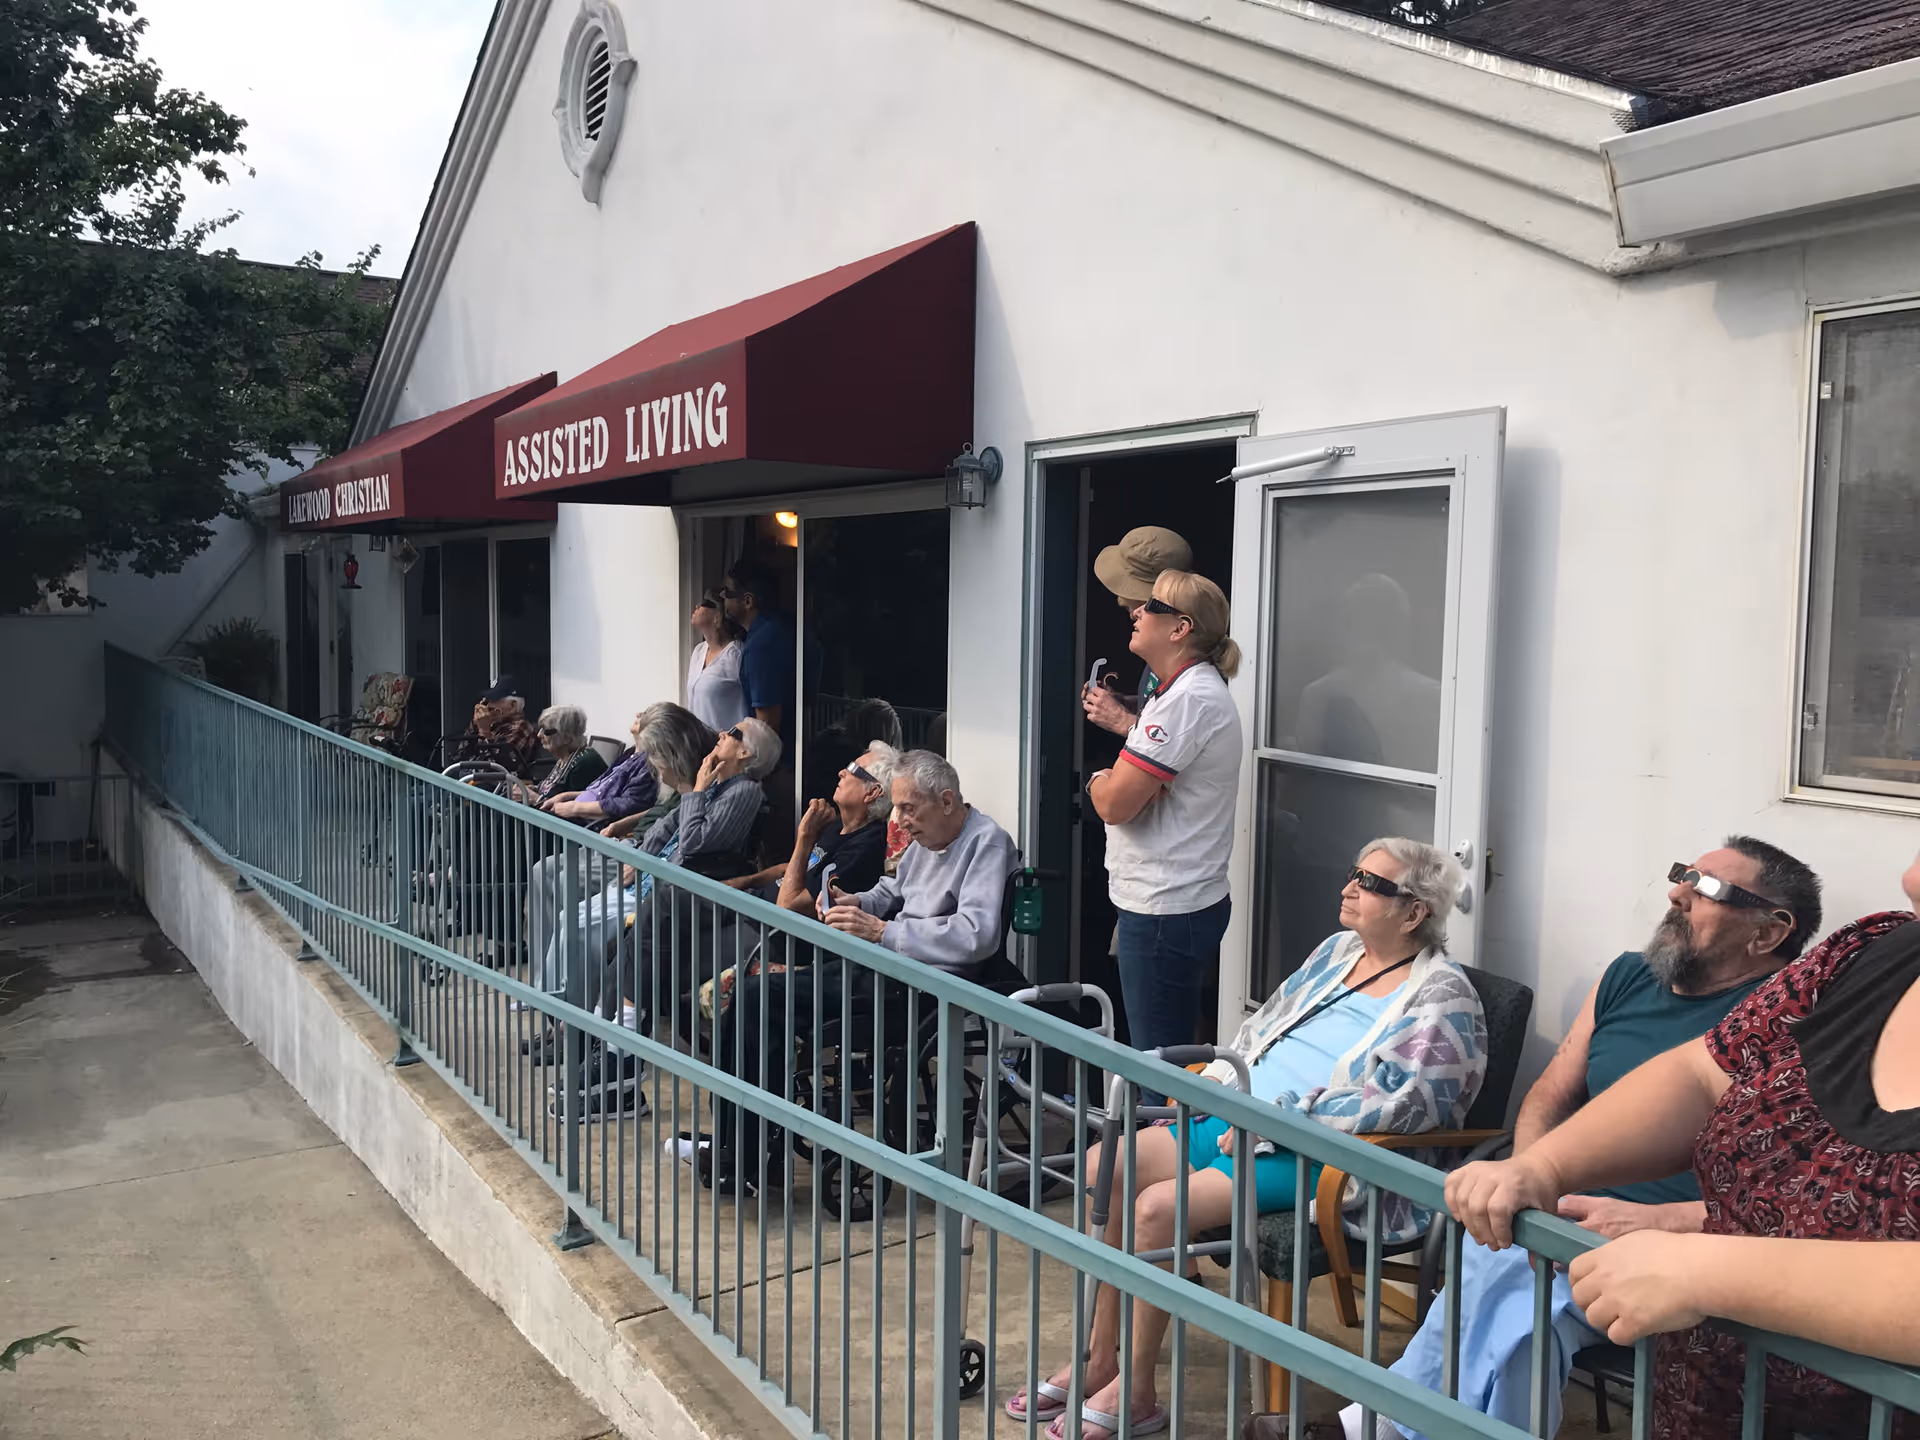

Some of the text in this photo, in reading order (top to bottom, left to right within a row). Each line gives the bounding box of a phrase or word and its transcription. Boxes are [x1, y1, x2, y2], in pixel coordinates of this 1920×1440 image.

[503, 381, 728, 486] ASSISTED LIVING
[288, 473, 390, 524] LAKEWOOD CHRISTIAN
